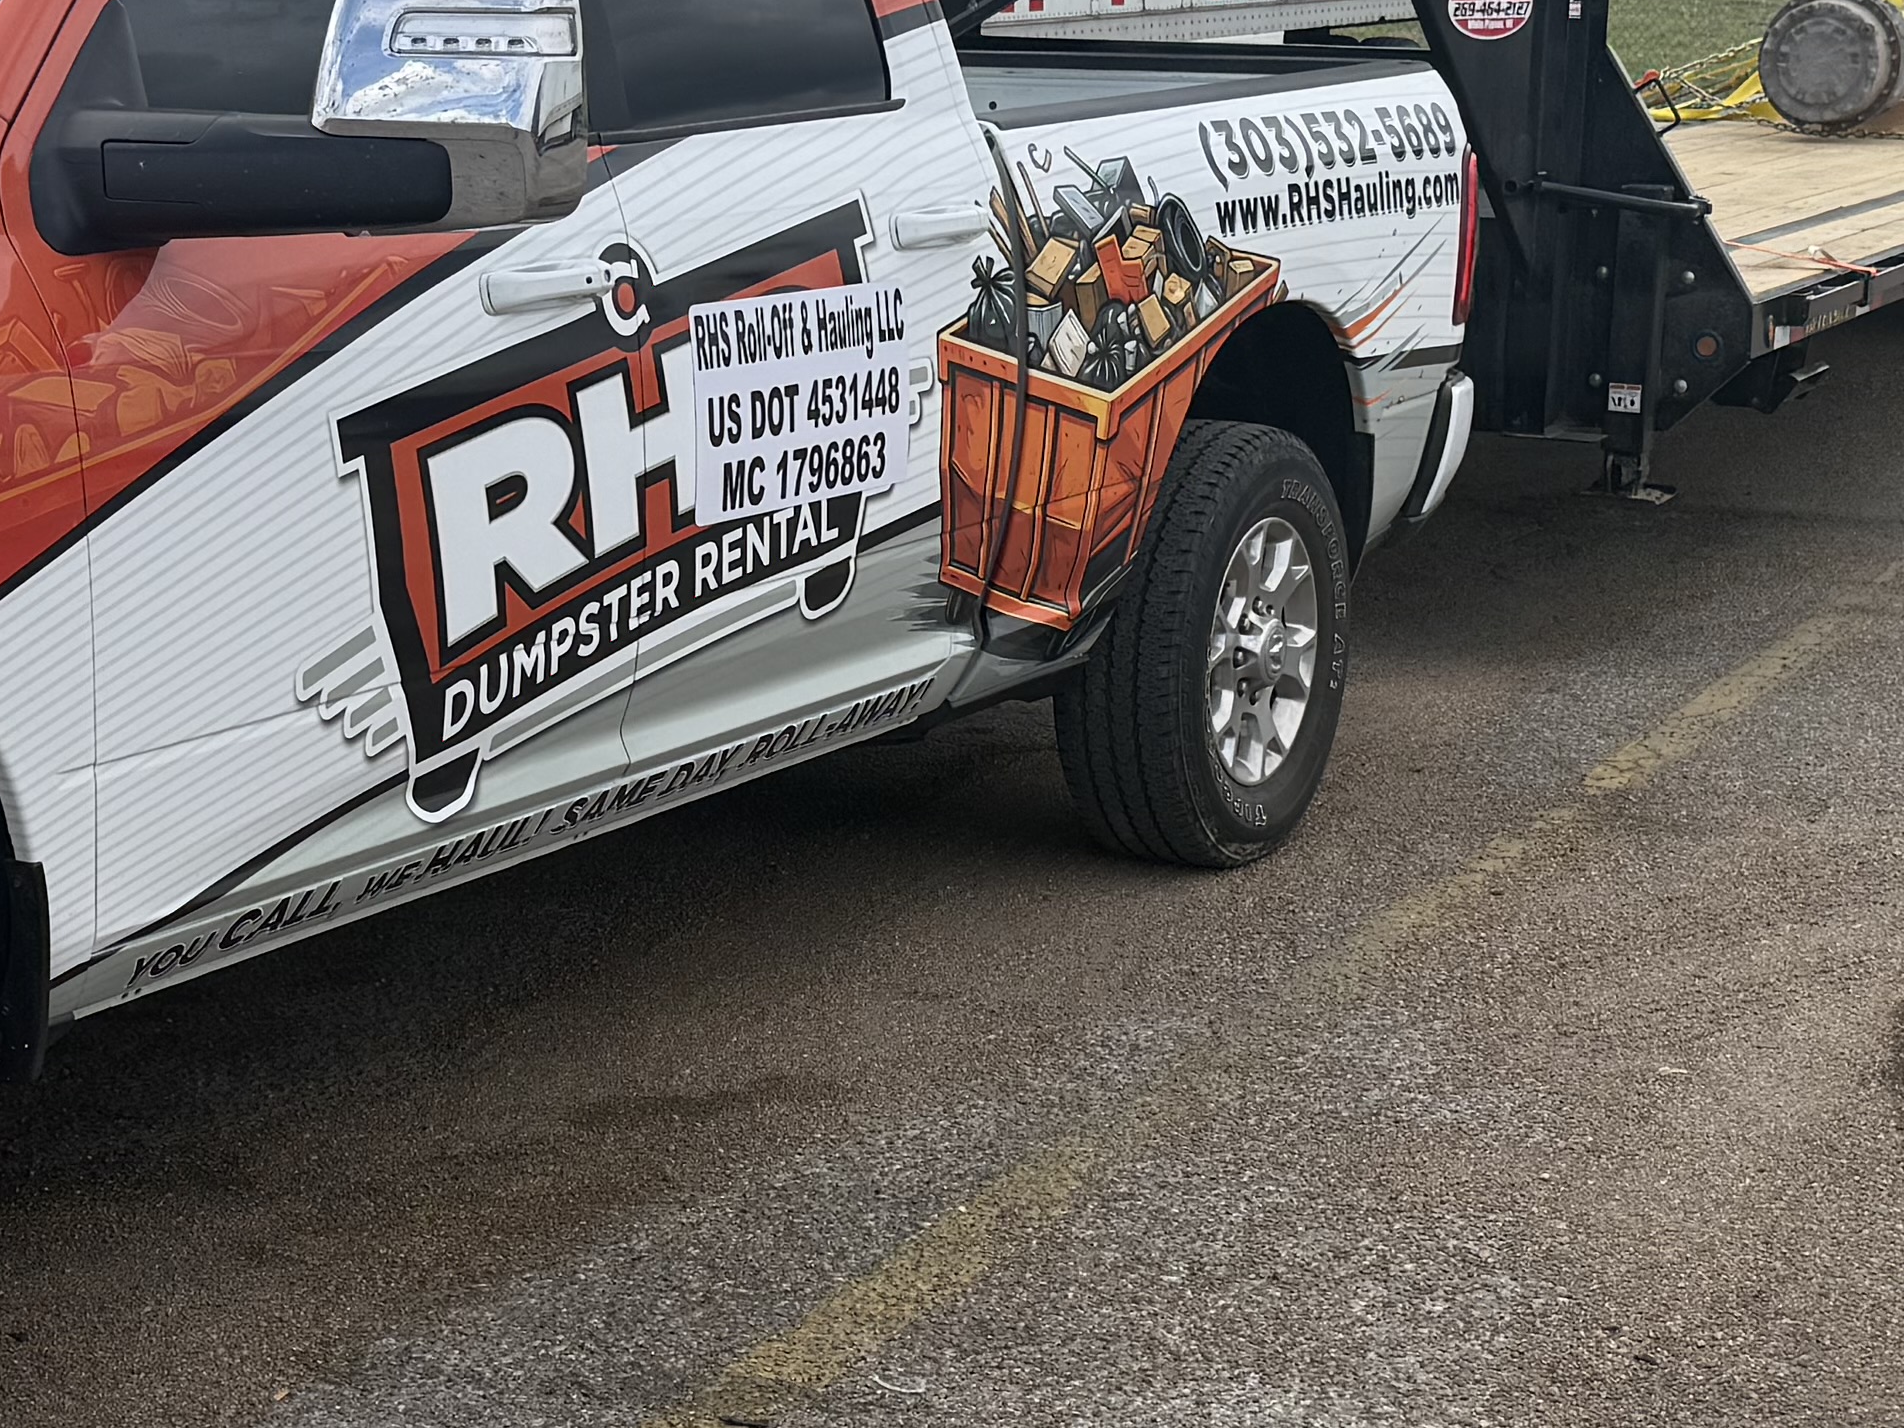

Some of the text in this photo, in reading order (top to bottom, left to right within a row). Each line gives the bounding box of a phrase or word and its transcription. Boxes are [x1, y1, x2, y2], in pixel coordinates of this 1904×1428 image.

[1199, 102, 1457, 192] (303)532-5689
[1215, 170, 1460, 237] www.RHSHauling.com
[693, 287, 904, 371] RHS Roll-Off & Hauling LLC
[707, 366, 900, 448] US DOT 4531448
[722, 431, 886, 512] MC 1796863
[442, 500, 840, 742] DUMPSTER RENTAL
[124, 930, 218, 990] YOU
[550, 770, 667, 835] SAME
[657, 741, 745, 798] DAY
[738, 675, 936, 768] ROLL-AWAY!
